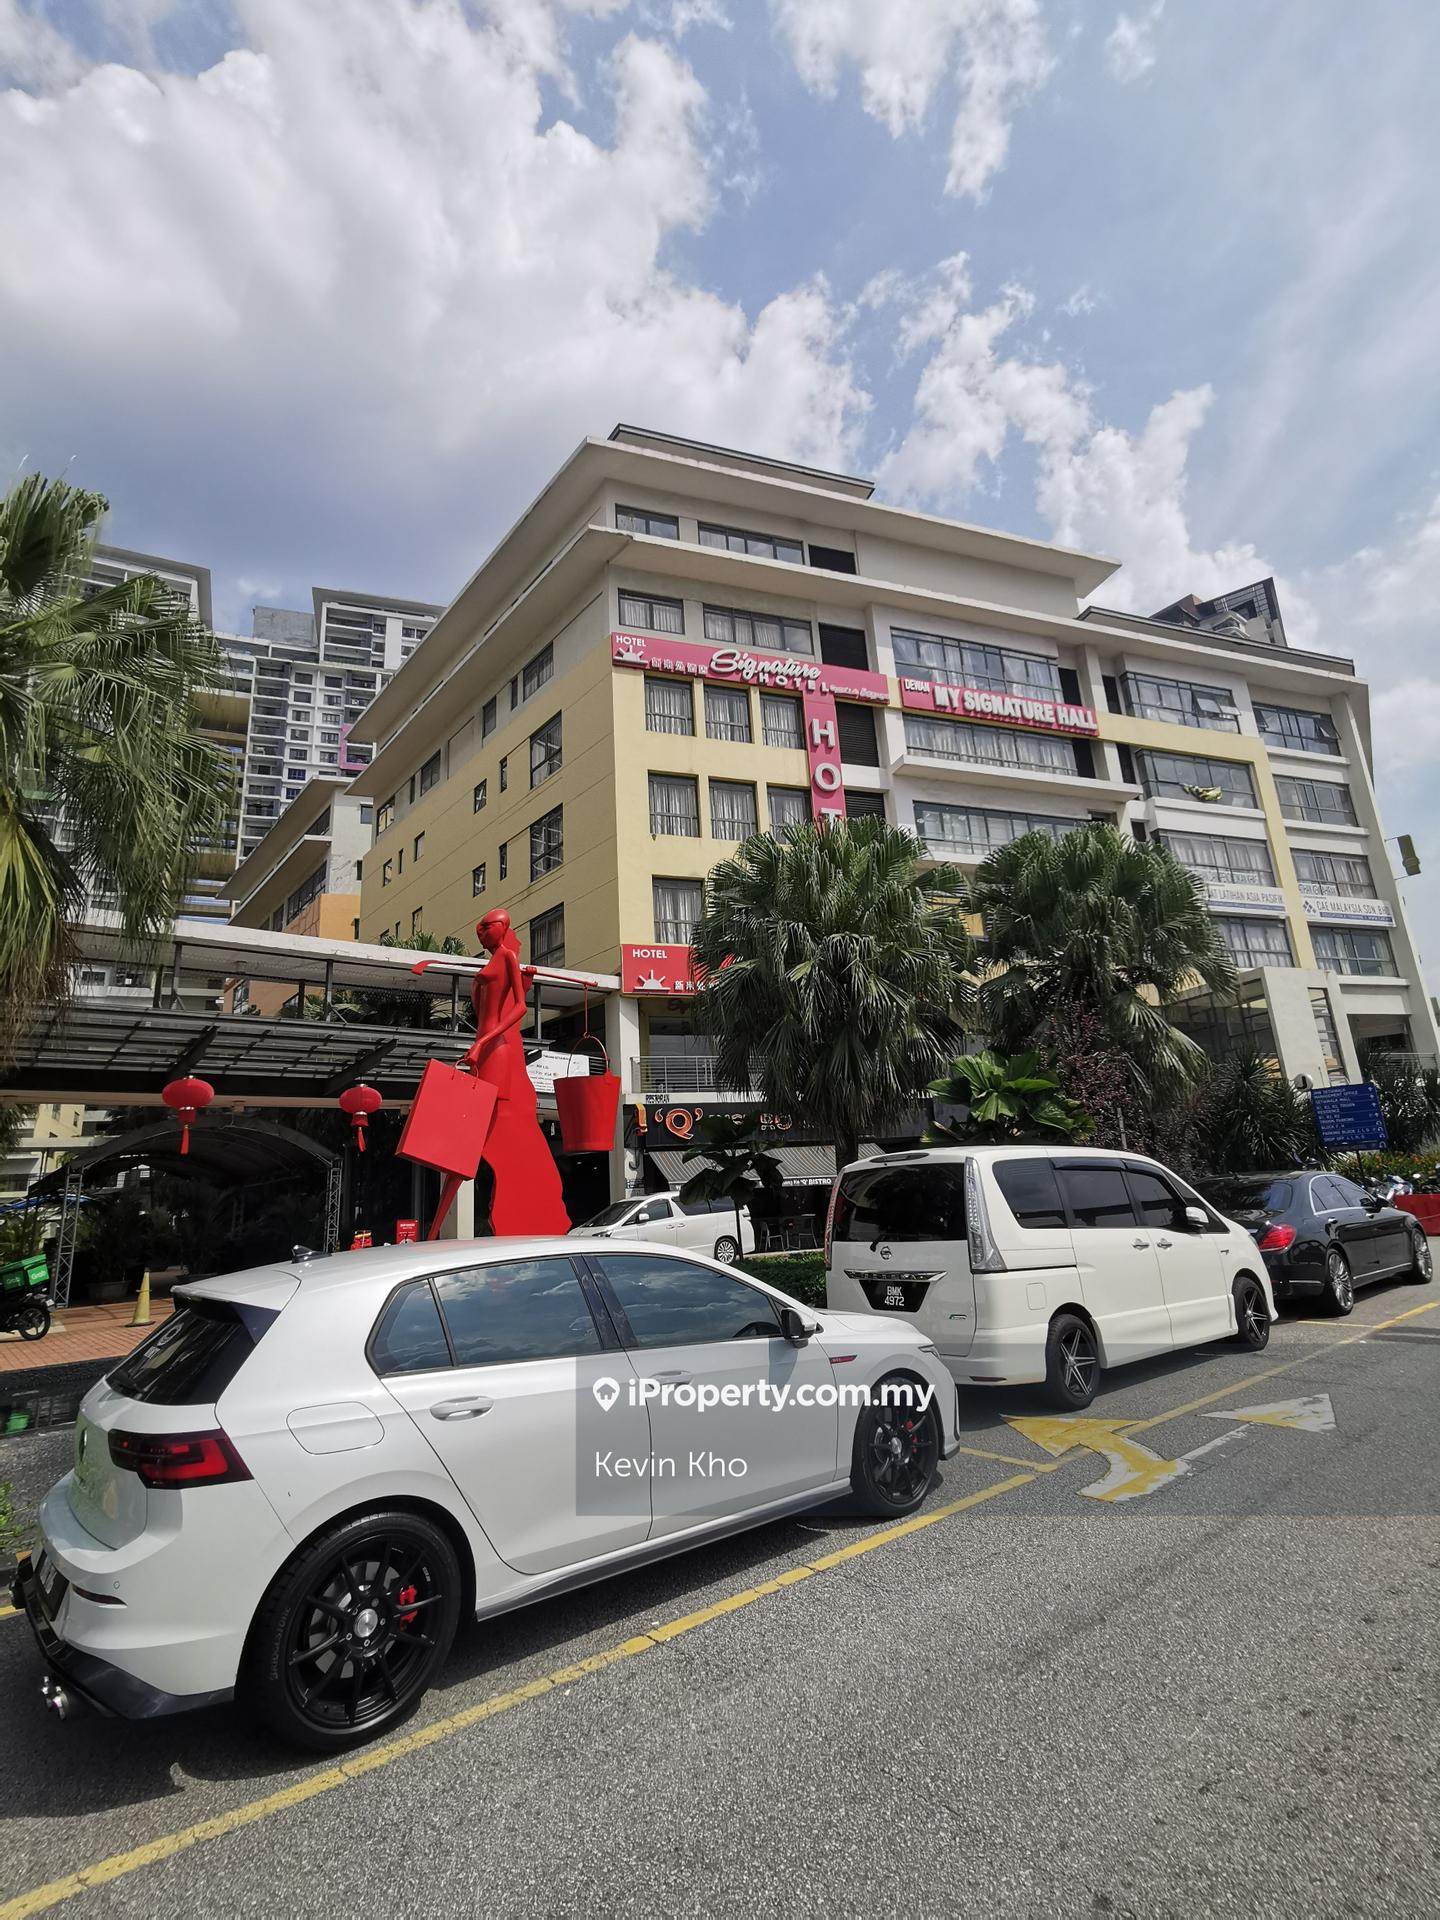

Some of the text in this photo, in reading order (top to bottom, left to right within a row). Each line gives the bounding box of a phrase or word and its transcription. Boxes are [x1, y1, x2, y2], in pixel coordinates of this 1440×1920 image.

[615, 634, 647, 647] HOTEL
[710, 649, 822, 681] Signature
[759, 673, 830, 692] HOTEL
[904, 679, 930, 693] DEWAN
[934, 685, 1097, 730] MY SIGNATURE HALL
[1219, 889, 1245, 901] LATIHAN
[1246, 891, 1260, 901] ASIA
[1316, 900, 1328, 911] CAE
[1330, 902, 1362, 913] MALAYSIA
[1363, 904, 1376, 914] SDN
[632, 948, 668, 959] HOTEL
[887, 1286, 902, 1296] BMK
[884, 1296, 905, 1306] 4972
